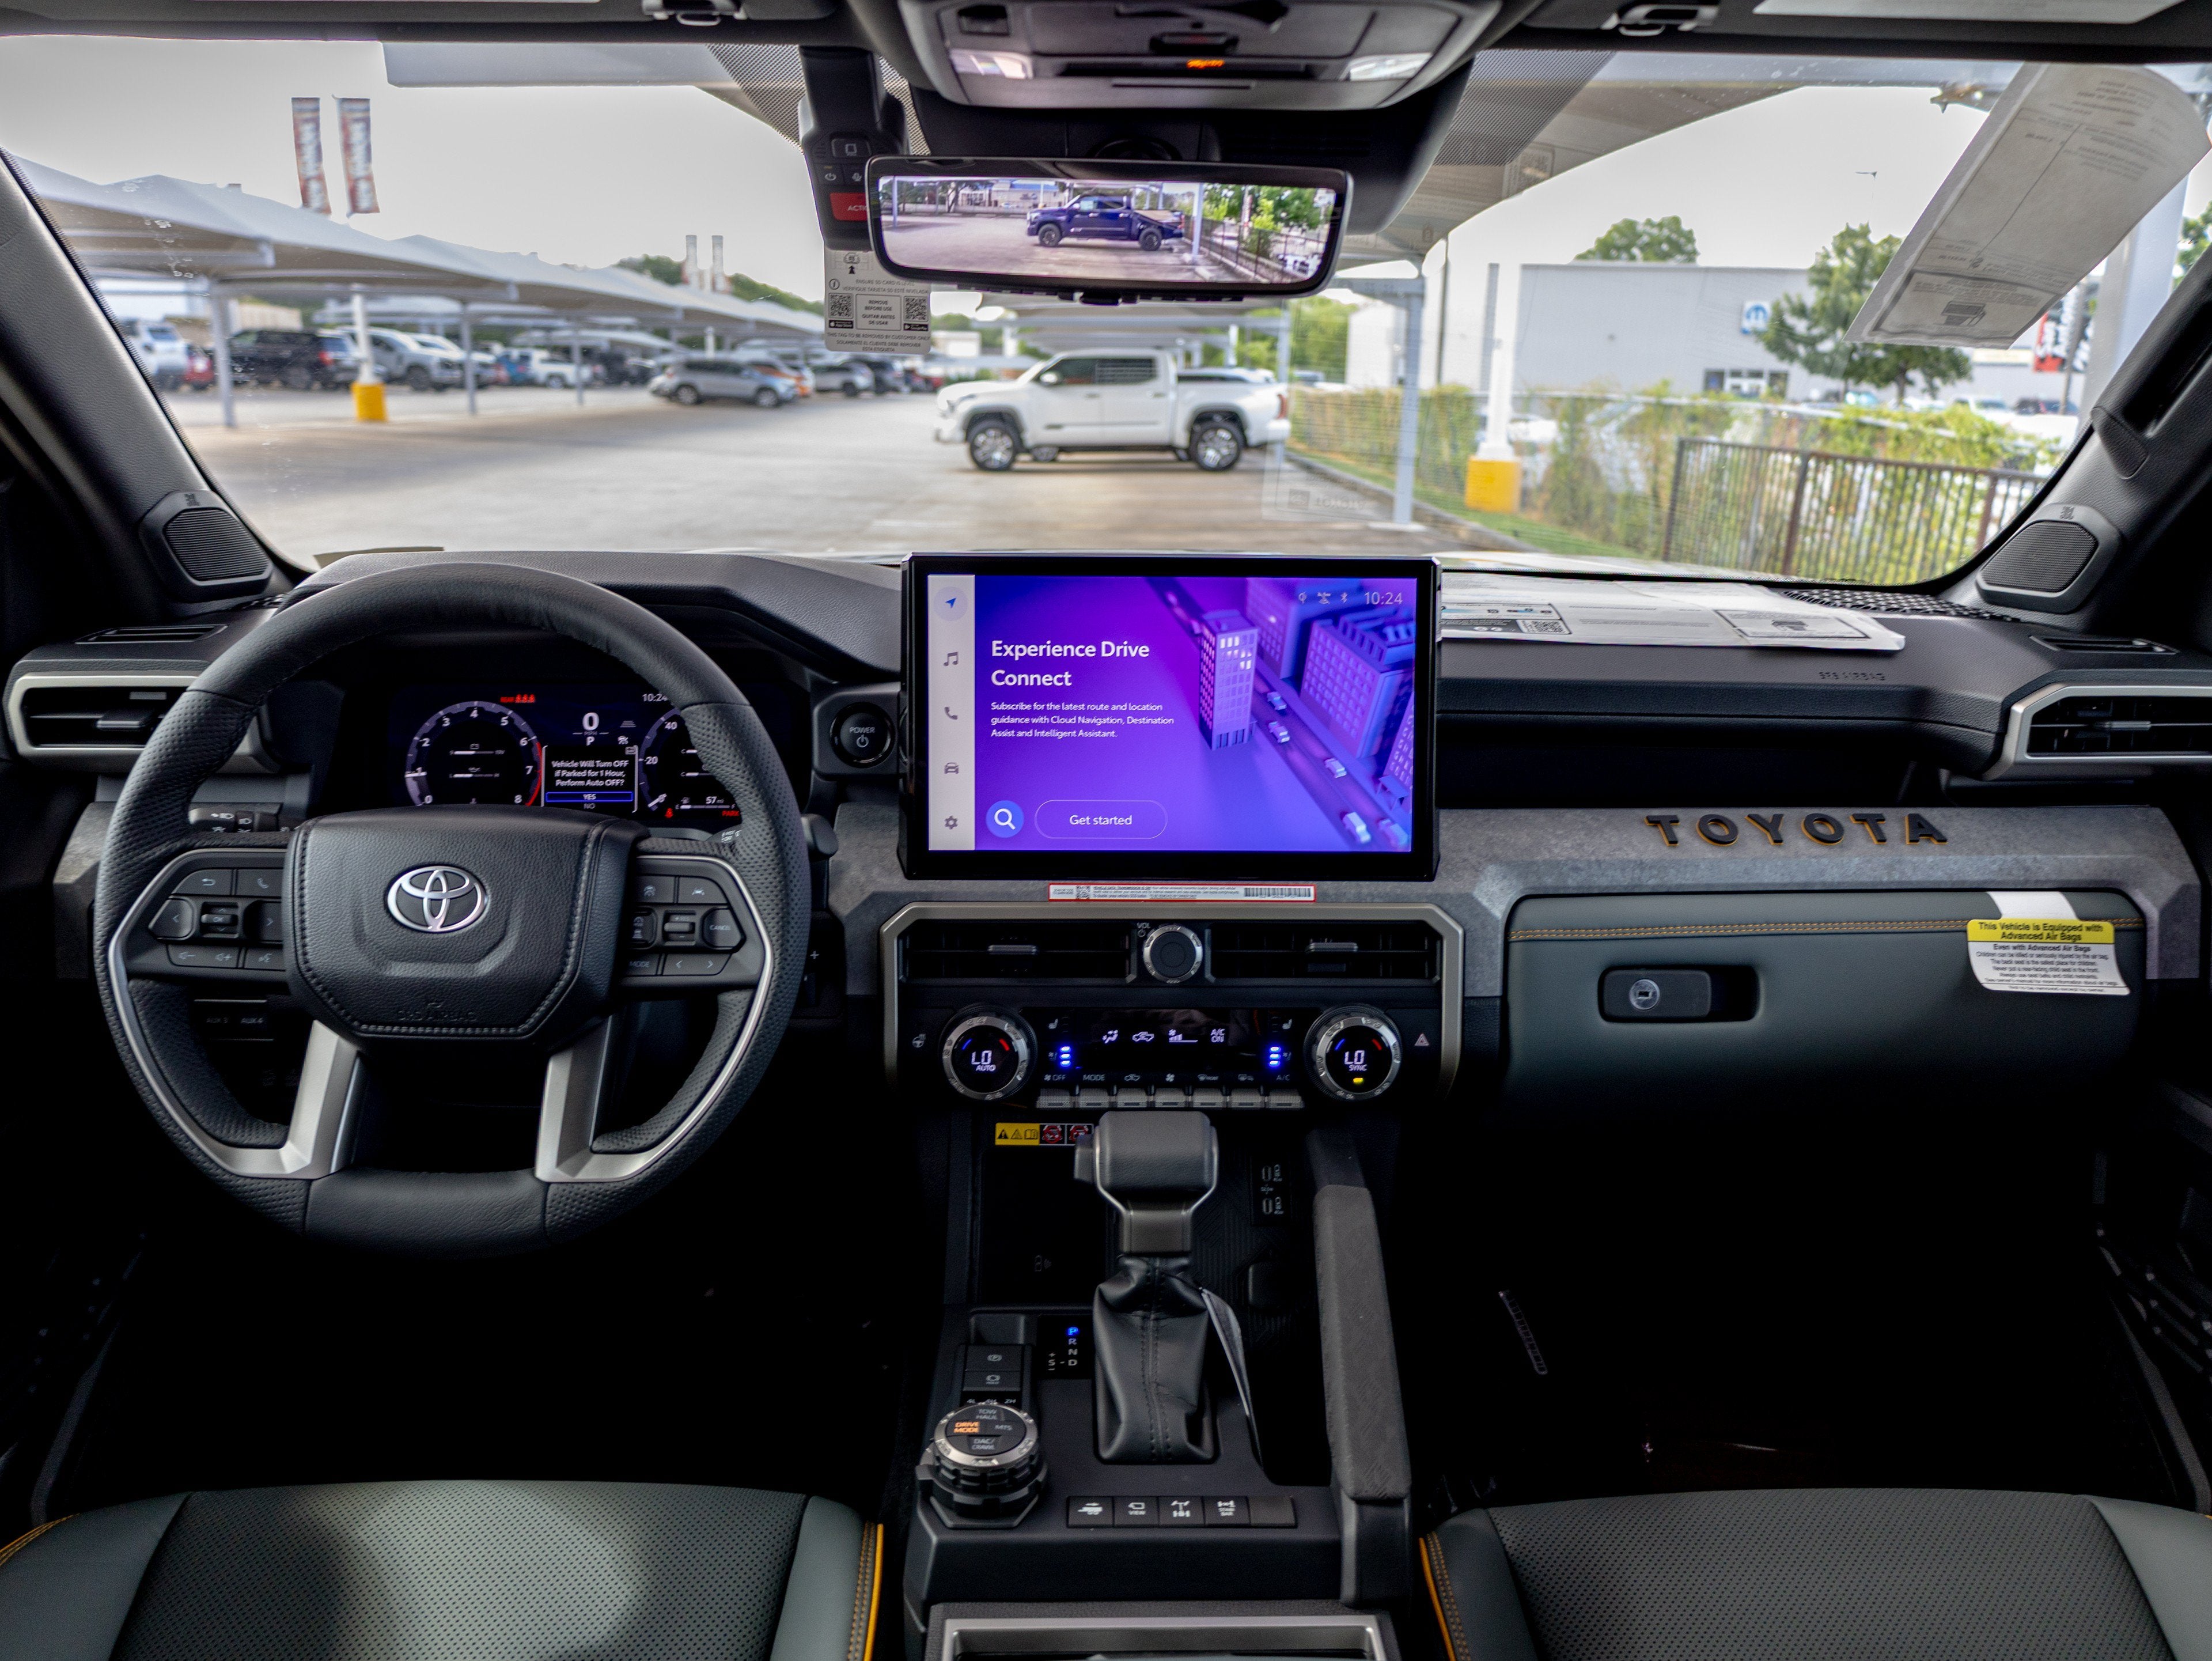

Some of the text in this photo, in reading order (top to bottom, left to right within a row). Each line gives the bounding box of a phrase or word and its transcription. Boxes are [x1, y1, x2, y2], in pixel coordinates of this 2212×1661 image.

[1364, 592, 1403, 606] 10:24
[991, 640, 1150, 661] Experience Drive
[991, 669, 1072, 686] Connect
[642, 694, 668, 702] 10:24
[991, 702, 1163, 711] Subscribe for the latest route and location
[470, 709, 479, 718] 4
[442, 717, 450, 727] 3
[501, 717, 509, 725] 5
[582, 712, 599, 731] 0
[991, 716, 1030, 725] guidance
[1050, 716, 1076, 724] Cloud
[1078, 716, 1125, 725] Navigation,
[665, 722, 677, 730] 40
[991, 729, 1118, 739] Assist and Intelligent Assistant.
[422, 738, 430, 747] 2
[520, 737, 528, 746] 6
[586, 736, 595, 746] P
[646, 756, 658, 765] 20
[525, 766, 533, 774] 7
[425, 795, 433, 804] 0
[514, 794, 522, 804] 8
[706, 796, 717, 804] 57
[1069, 814, 1132, 826] Get started
[1644, 812, 1948, 846] TOYOTA
[1978, 922, 1997, 930] This
[2000, 922, 2030, 931] Vehicle
[2043, 924, 2083, 933] Equipped
[2001, 932, 2043, 940] Advanced
[2060, 933, 2082, 942] Bags
[971, 1050, 993, 1065] LO
[1344, 1050, 1365, 1065] LO
